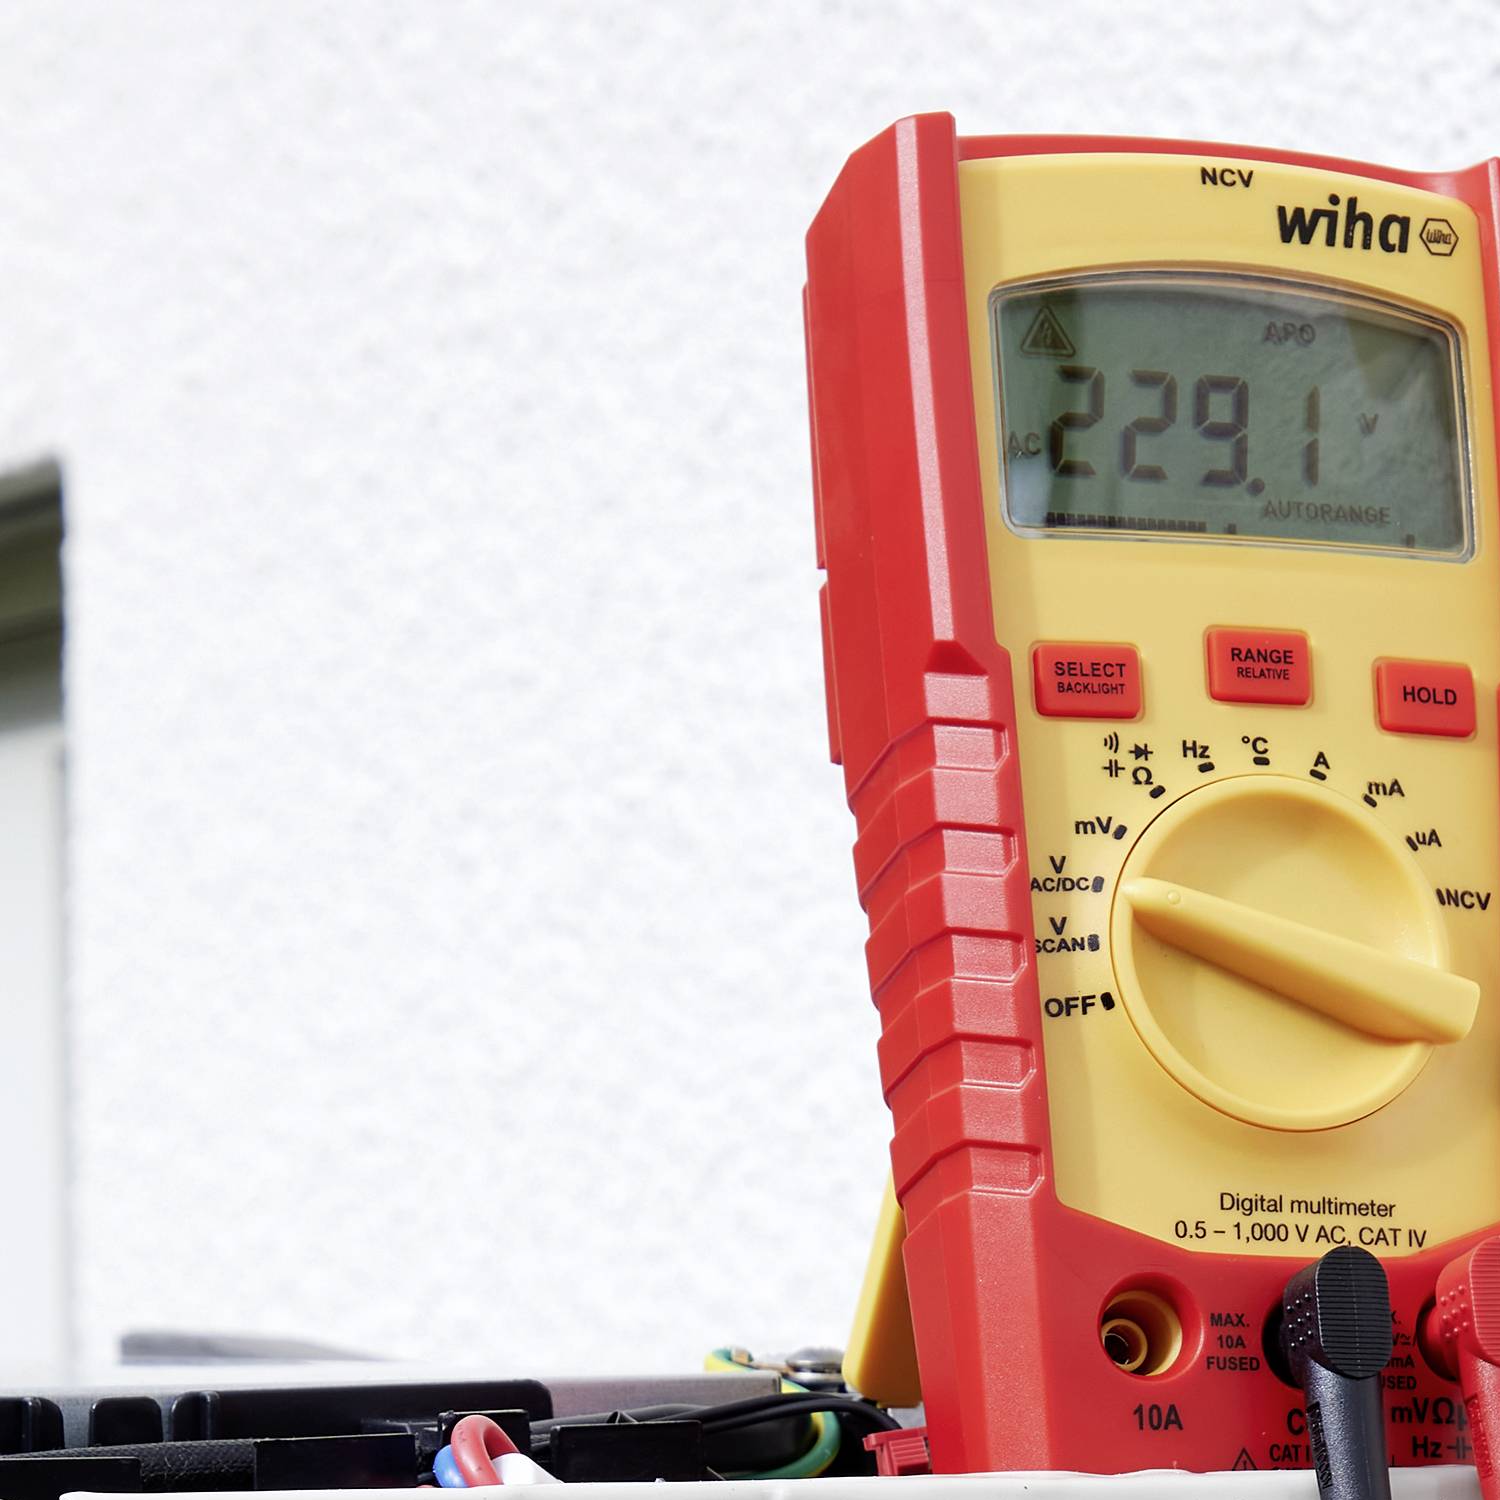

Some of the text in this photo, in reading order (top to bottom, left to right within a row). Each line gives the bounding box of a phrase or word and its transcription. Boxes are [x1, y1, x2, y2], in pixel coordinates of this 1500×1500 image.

[1200, 166, 1254, 188] NCV
[1277, 194, 1411, 254] wiha
[1263, 321, 1316, 348] APO
[1006, 432, 1041, 458] AC
[1049, 364, 1321, 495] 229.1
[1263, 500, 1393, 526] AUTORANGE
[1230, 647, 1295, 666] RANGE
[1053, 659, 1127, 679] SELECT
[1236, 666, 1291, 682] RELATIVE
[1056, 680, 1127, 697] BACKLIGHT
[1402, 685, 1458, 706] HOLD
[1181, 739, 1211, 760] Hz
[1240, 734, 1270, 756] °C
[1312, 751, 1331, 771] A
[1367, 778, 1405, 797] mA
[1075, 816, 1114, 836] mV
[1049, 855, 1067, 875] V
[1030, 876, 1090, 893] AC/DC
[1445, 888, 1492, 911] NCV
[1049, 916, 1067, 936] V
[1044, 994, 1097, 1018] OFF
[1219, 1192, 1397, 1218] Digital multimeter
[1174, 1220, 1207, 1240] 0.5
[1234, 1222, 1290, 1244] 1,000
[1296, 1224, 1314, 1244] V
[1315, 1225, 1352, 1248] AC,
[1358, 1227, 1403, 1248] CAT
[1407, 1229, 1428, 1249] IV
[1209, 1312, 1251, 1328] MAX.
[1217, 1333, 1247, 1350] 10A
[1206, 1355, 1260, 1372] FUSED
[1132, 1403, 1184, 1432] 10A
[1268, 1442, 1302, 1463] CAT
[1411, 1435, 1443, 1459] Hz
